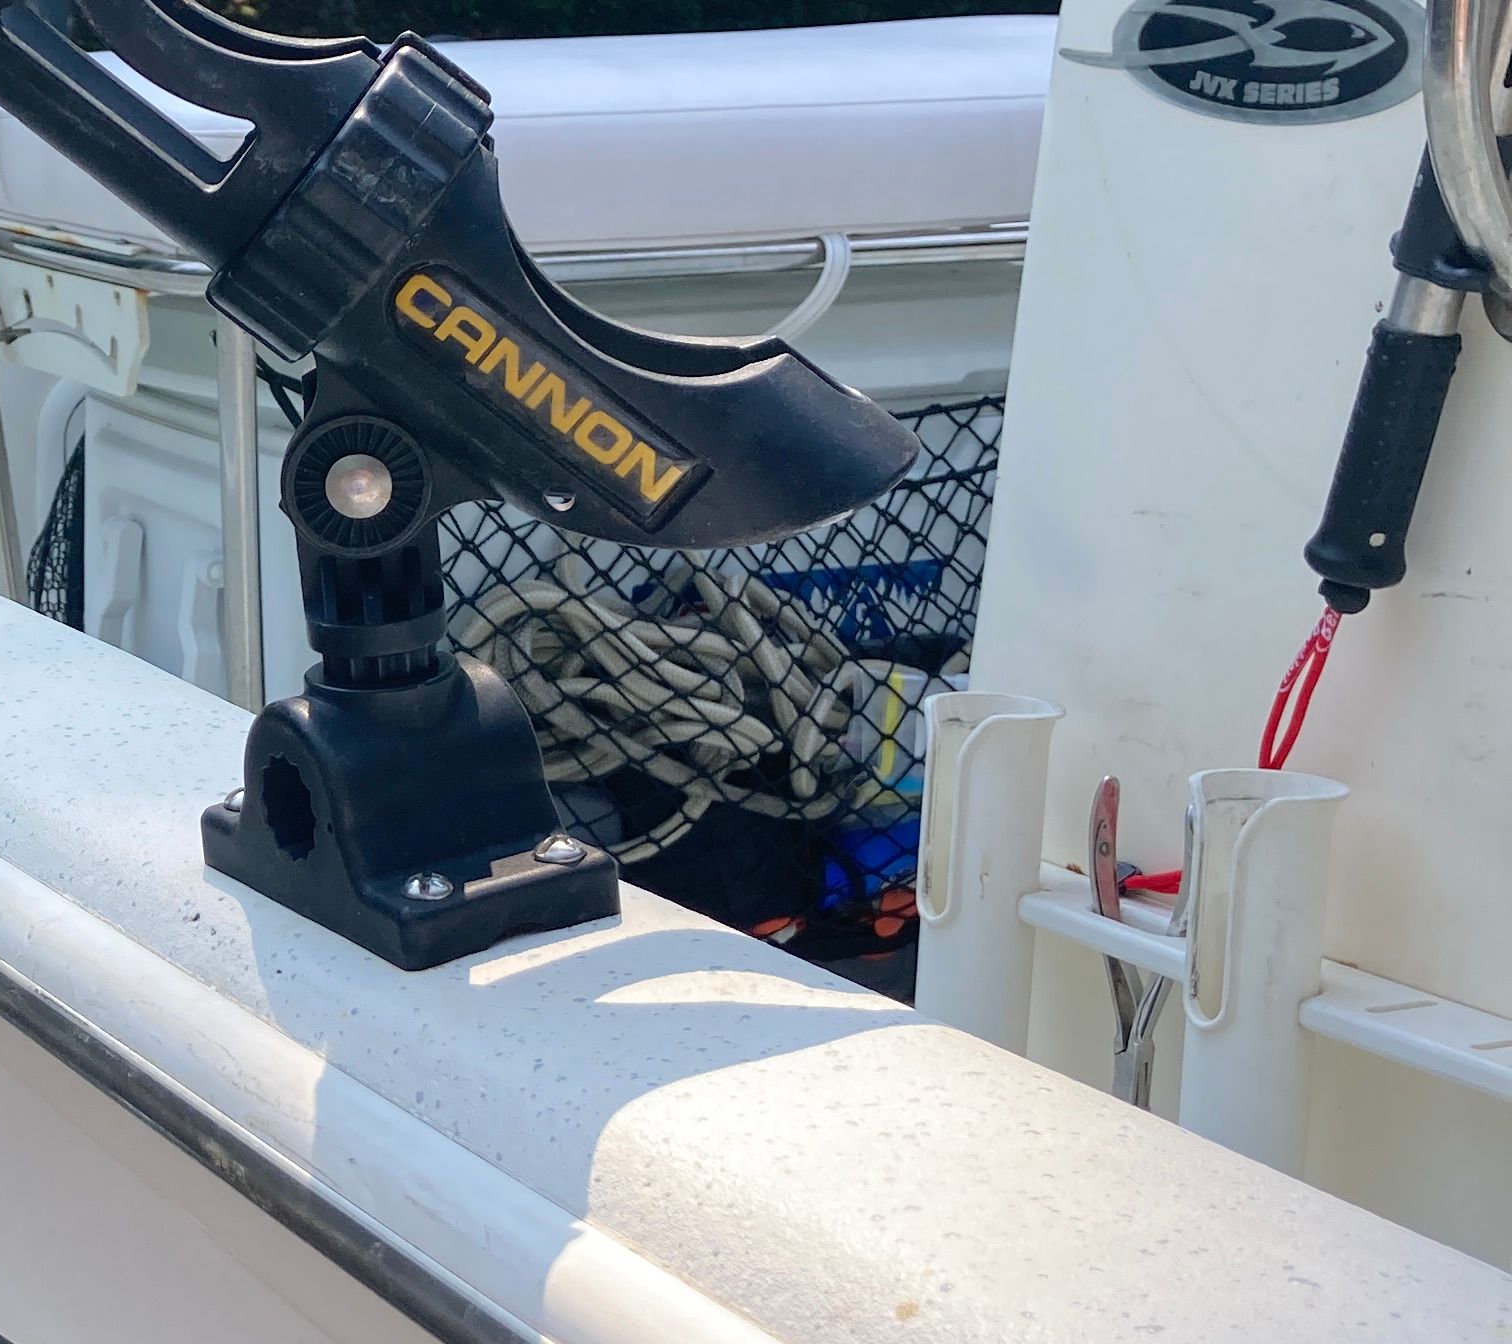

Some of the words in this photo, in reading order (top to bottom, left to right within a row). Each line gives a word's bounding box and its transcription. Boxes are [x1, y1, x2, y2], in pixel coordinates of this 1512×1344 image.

[1189, 70, 1238, 101] JVX
[1242, 76, 1340, 106] SERIES
[394, 273, 683, 504] CANNON
